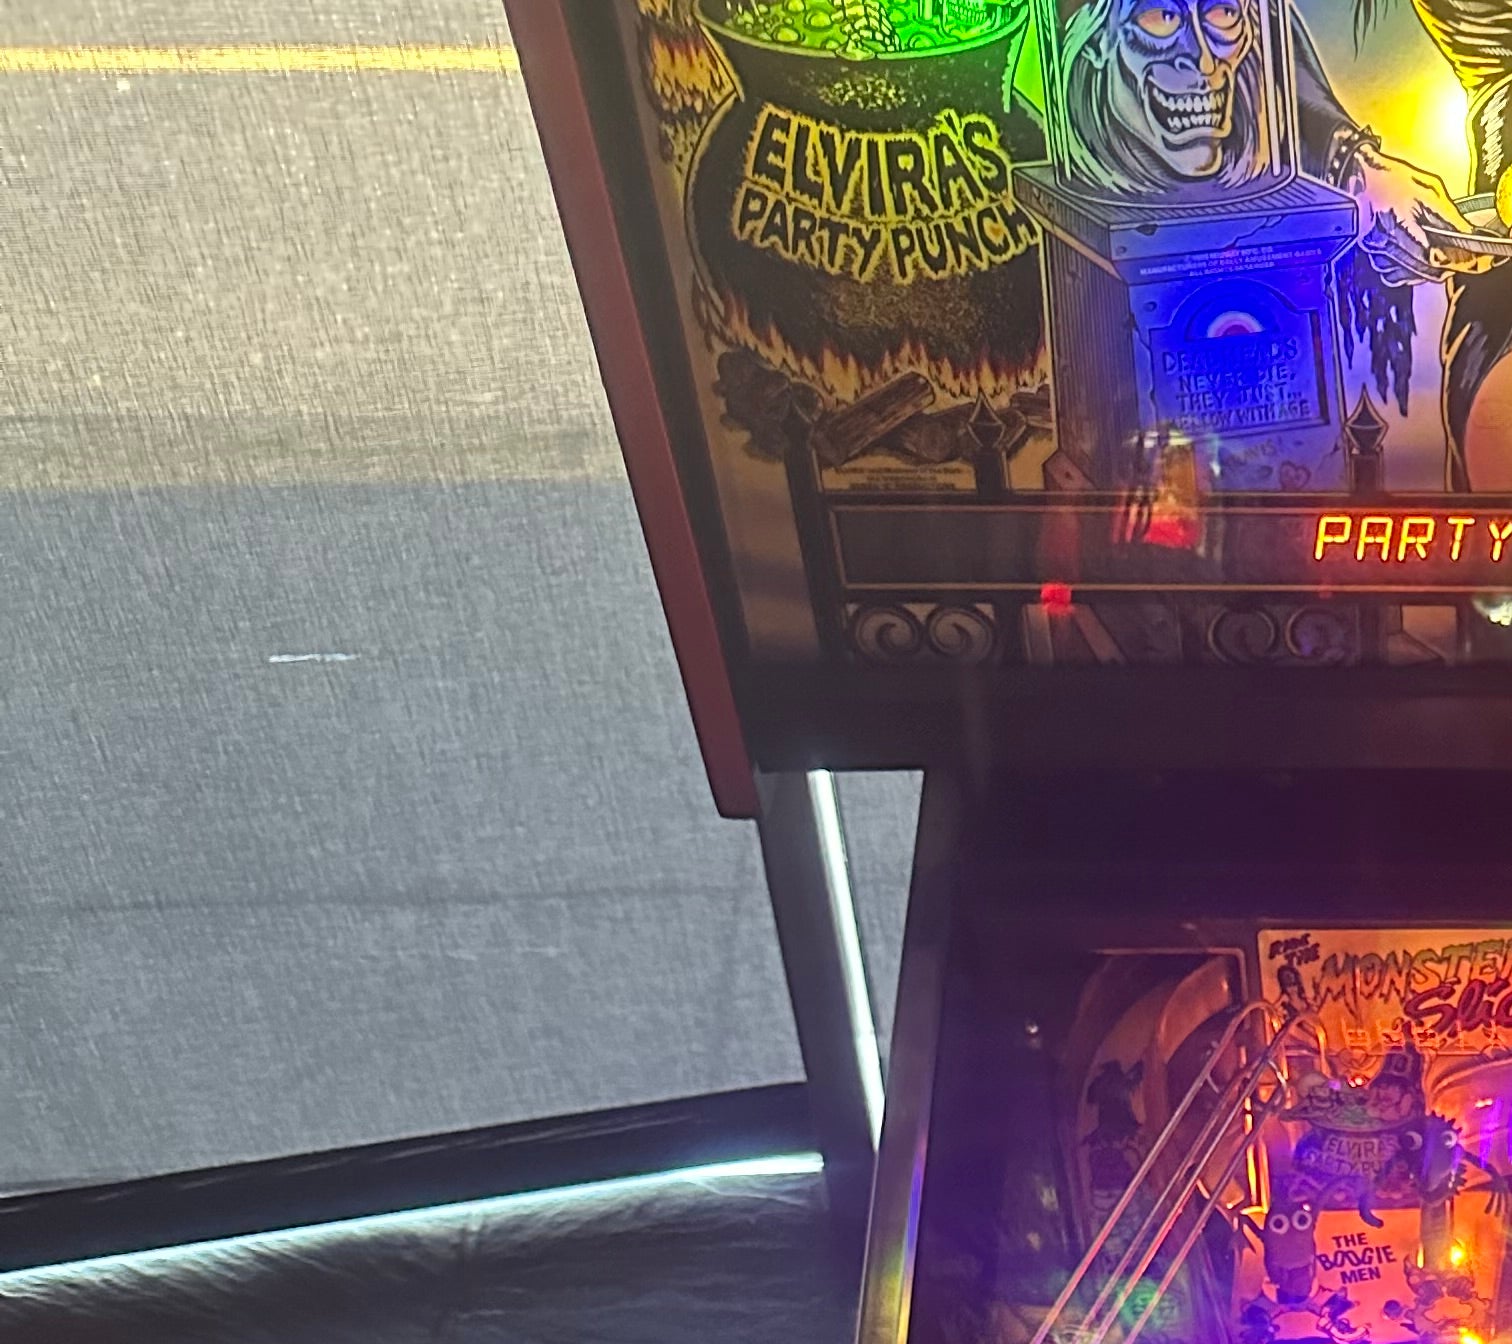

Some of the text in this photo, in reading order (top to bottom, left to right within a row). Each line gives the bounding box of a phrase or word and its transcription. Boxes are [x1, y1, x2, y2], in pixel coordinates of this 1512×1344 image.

[749, 106, 1009, 220] ELVIRA'S
[737, 189, 1039, 280] PARTY PUNCH
[1332, 1232, 1368, 1249] THE
[1316, 1244, 1397, 1272] BOOGIE
[1339, 1265, 1381, 1285] MEN
